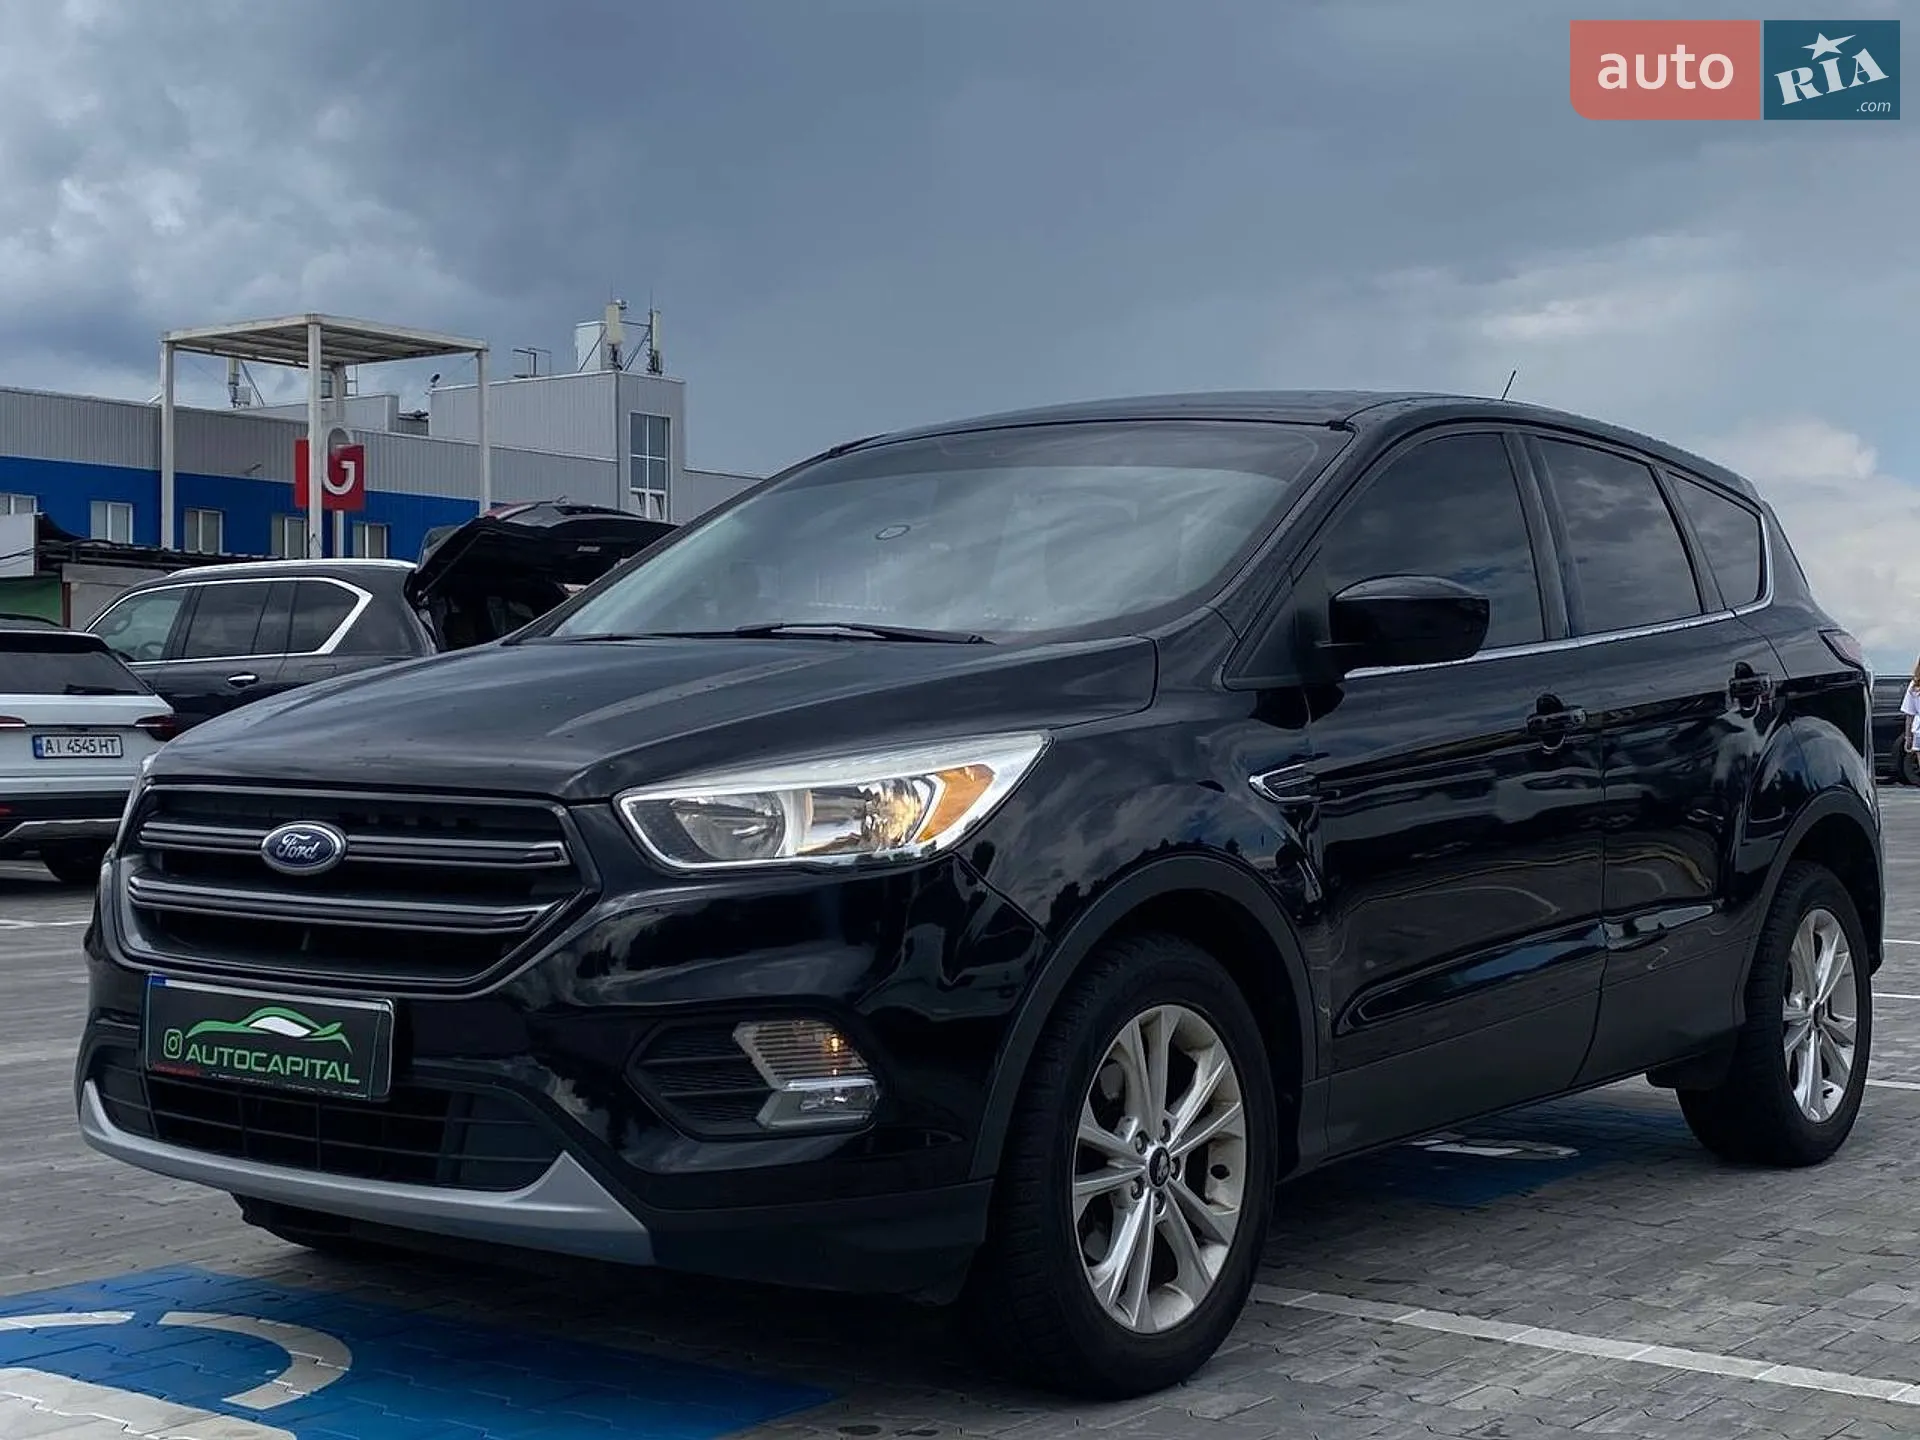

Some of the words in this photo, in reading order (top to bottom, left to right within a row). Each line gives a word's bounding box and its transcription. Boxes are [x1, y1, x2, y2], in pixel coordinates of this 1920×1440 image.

[67, 738, 96, 754] 4545
[99, 738, 116, 754] HT
[276, 832, 320, 860] Ford
[185, 1043, 360, 1084] AUTOCAPITAL
